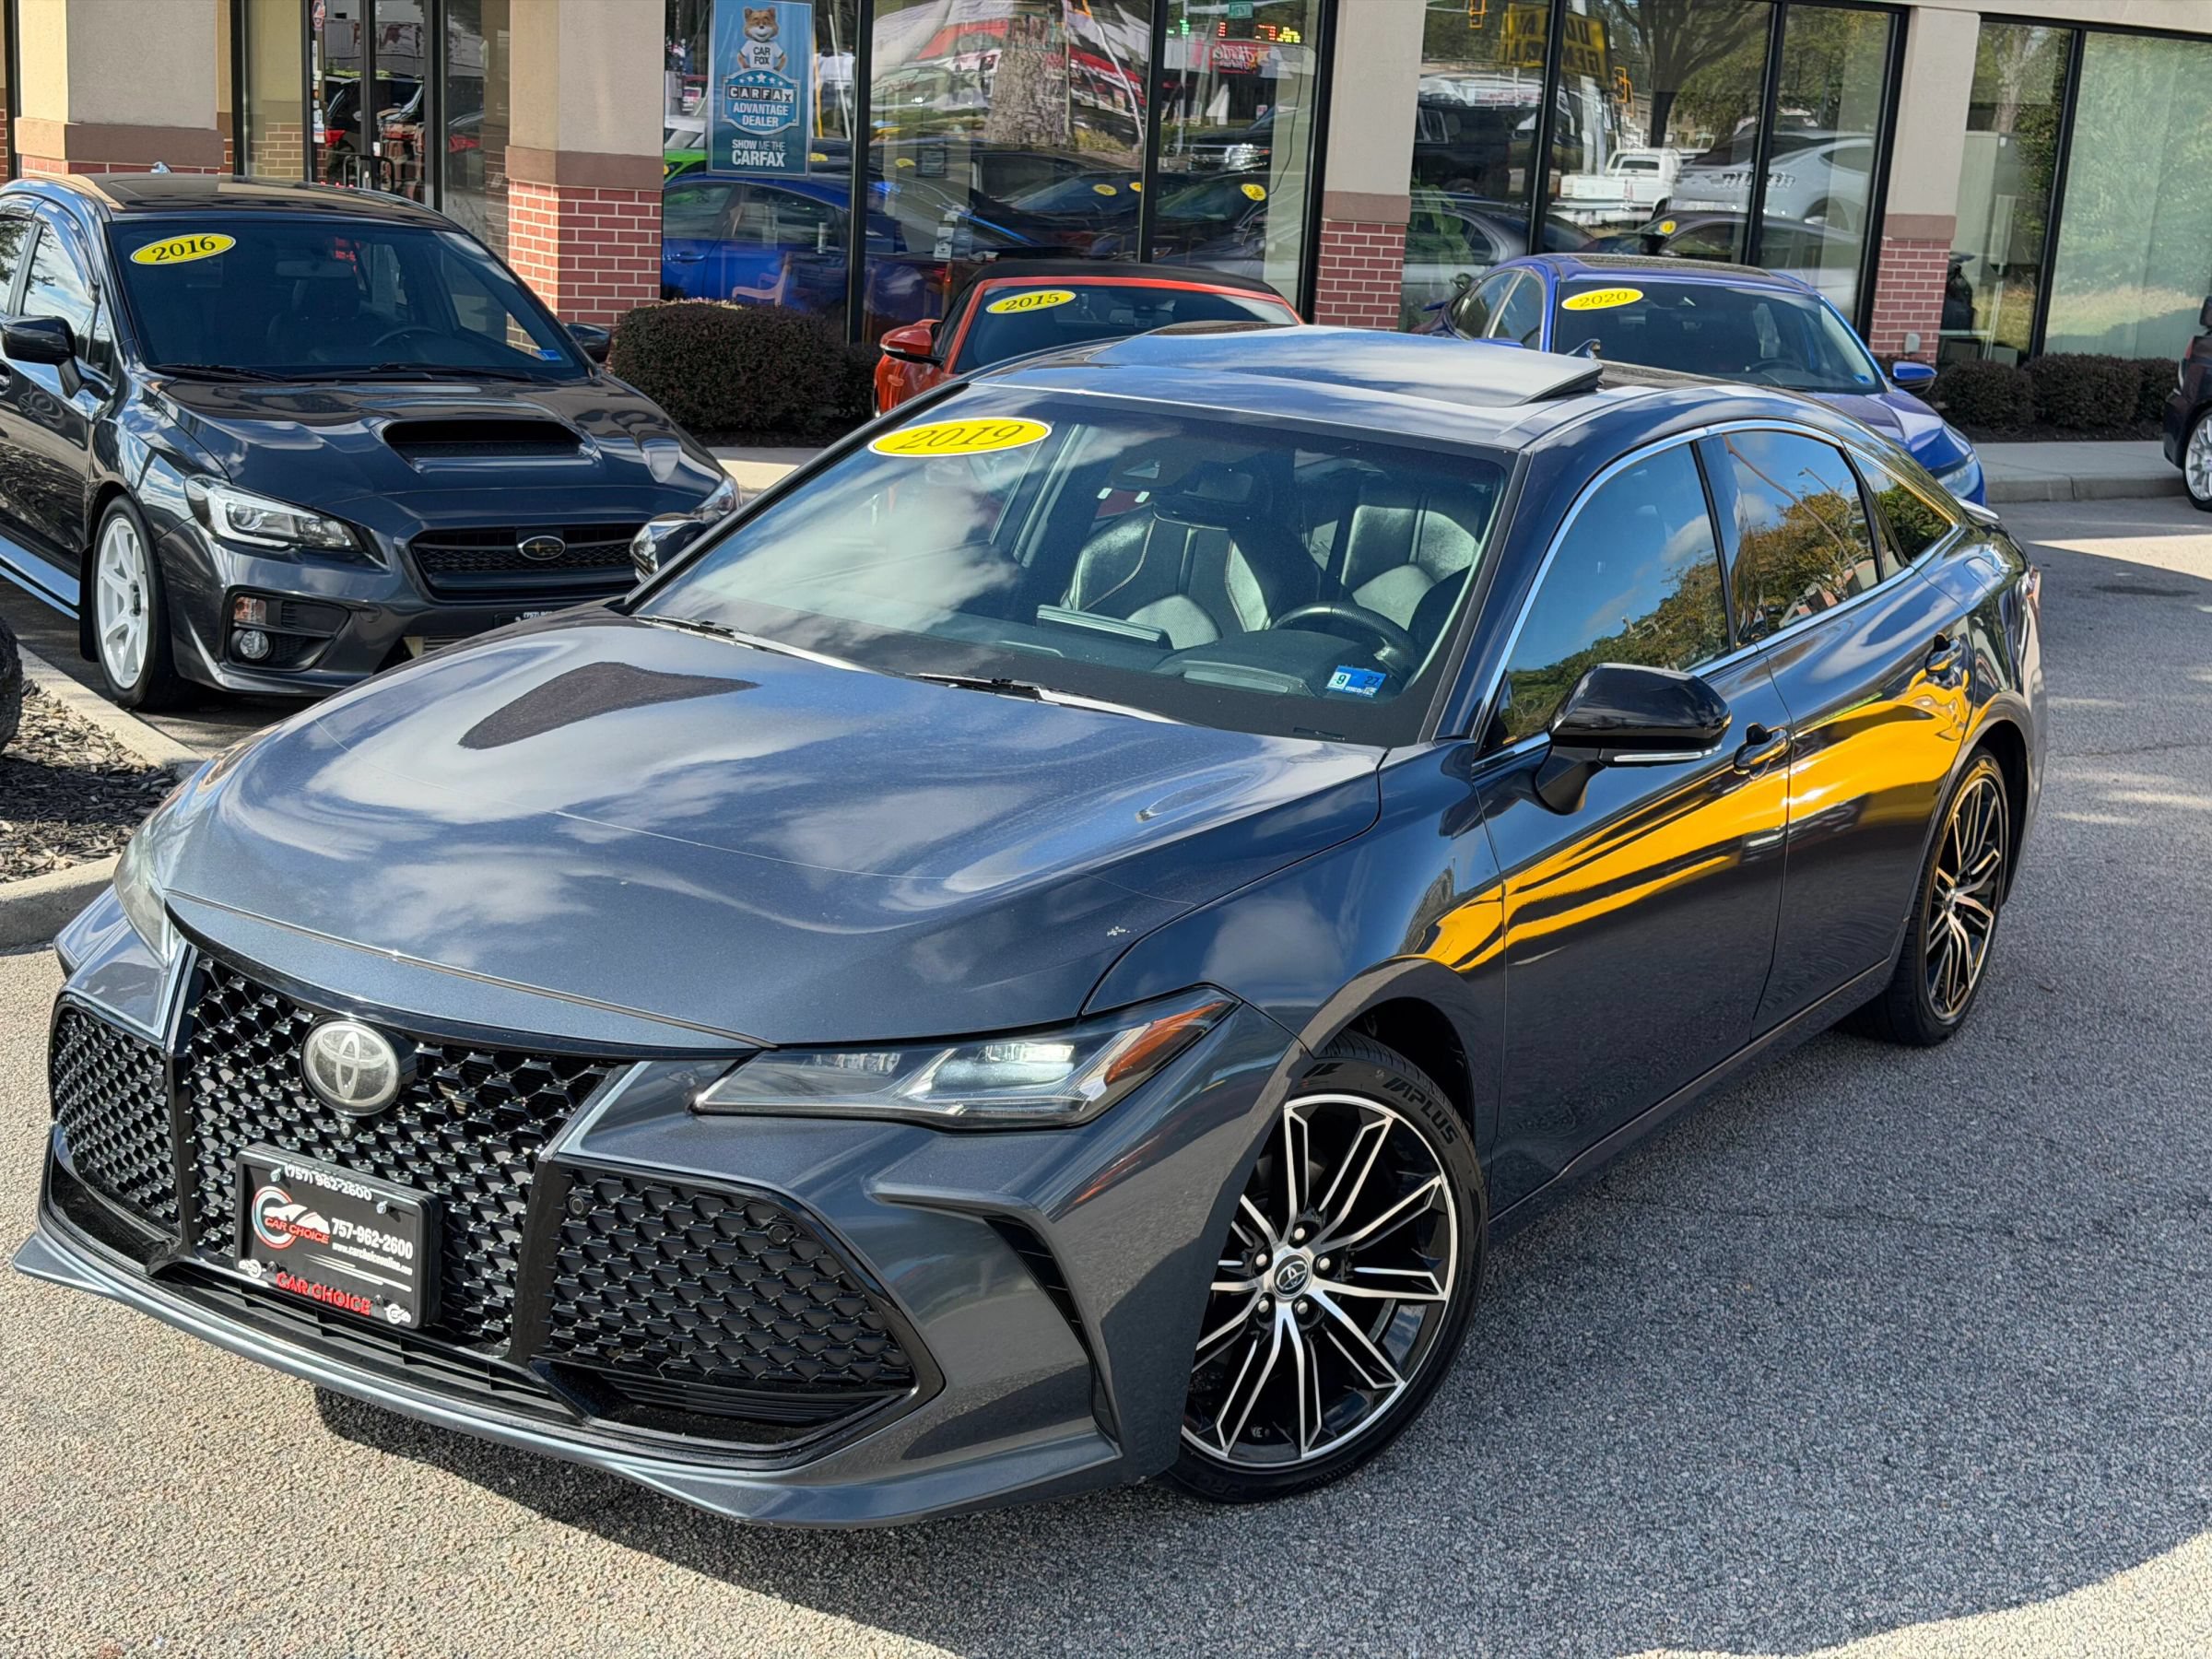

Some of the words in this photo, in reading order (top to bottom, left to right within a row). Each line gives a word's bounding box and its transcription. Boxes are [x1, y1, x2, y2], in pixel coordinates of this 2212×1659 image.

[753, 47, 771, 56] CAR
[754, 56, 771, 65] FOX
[729, 87, 794, 103] CARFAX
[733, 102, 789, 116] ADVANTAGE
[742, 114, 779, 127] DEALER
[732, 139, 758, 150] SHOW
[759, 140, 771, 150] ME
[771, 141, 785, 151] THE
[732, 150, 785, 168] CARFAX
[151, 236, 216, 261] 2016
[1004, 293, 1060, 311] 2015
[1579, 292, 1628, 307] 2020
[894, 425, 1025, 450] 2019
[1336, 675, 1347, 685] 9
[1364, 676, 1381, 686] 27
[1383, 1077, 1459, 1145] APLUS
[284, 1164, 313, 1183] (757)
[315, 1172, 372, 1201] 962-2600
[265, 1218, 288, 1231] CAR
[288, 1224, 331, 1244] CHOICE
[331, 1218, 414, 1259] 757-962-2600
[276, 1271, 310, 1296] CAR
[311, 1284, 372, 1316] CHOICE
